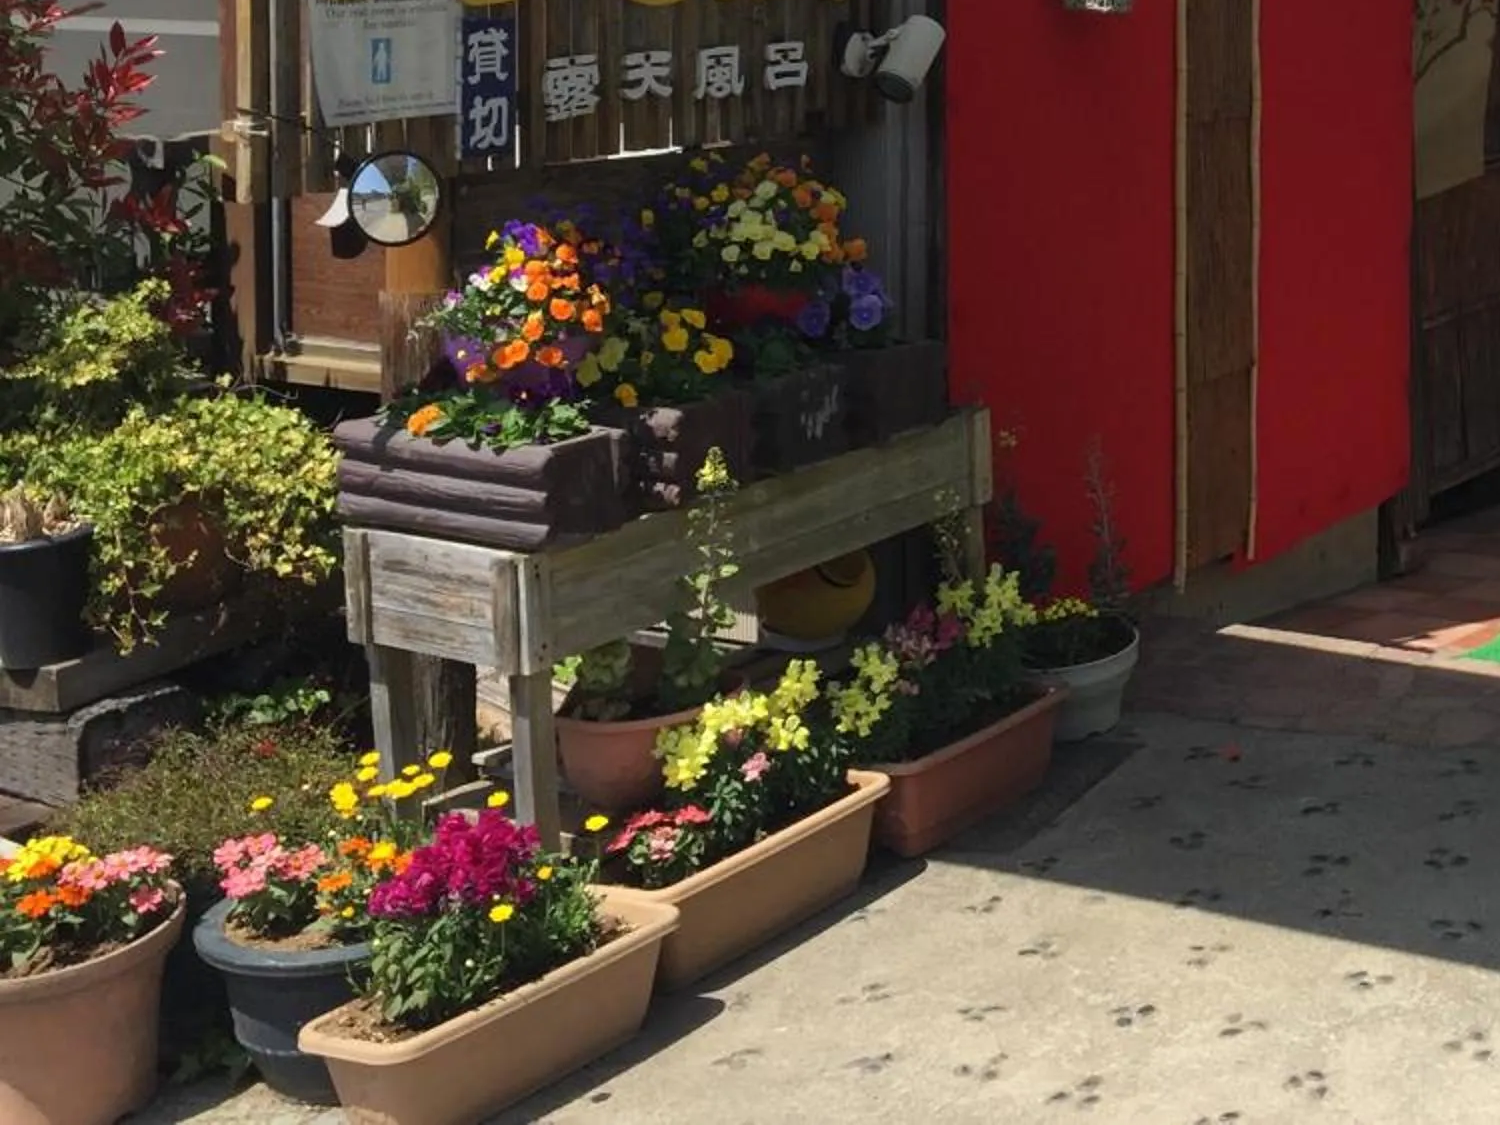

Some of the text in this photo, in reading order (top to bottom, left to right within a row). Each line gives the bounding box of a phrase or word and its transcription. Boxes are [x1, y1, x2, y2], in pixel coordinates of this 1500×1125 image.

[467, 27, 509, 151] 貸切
[542, 41, 808, 122] 露天風呂
